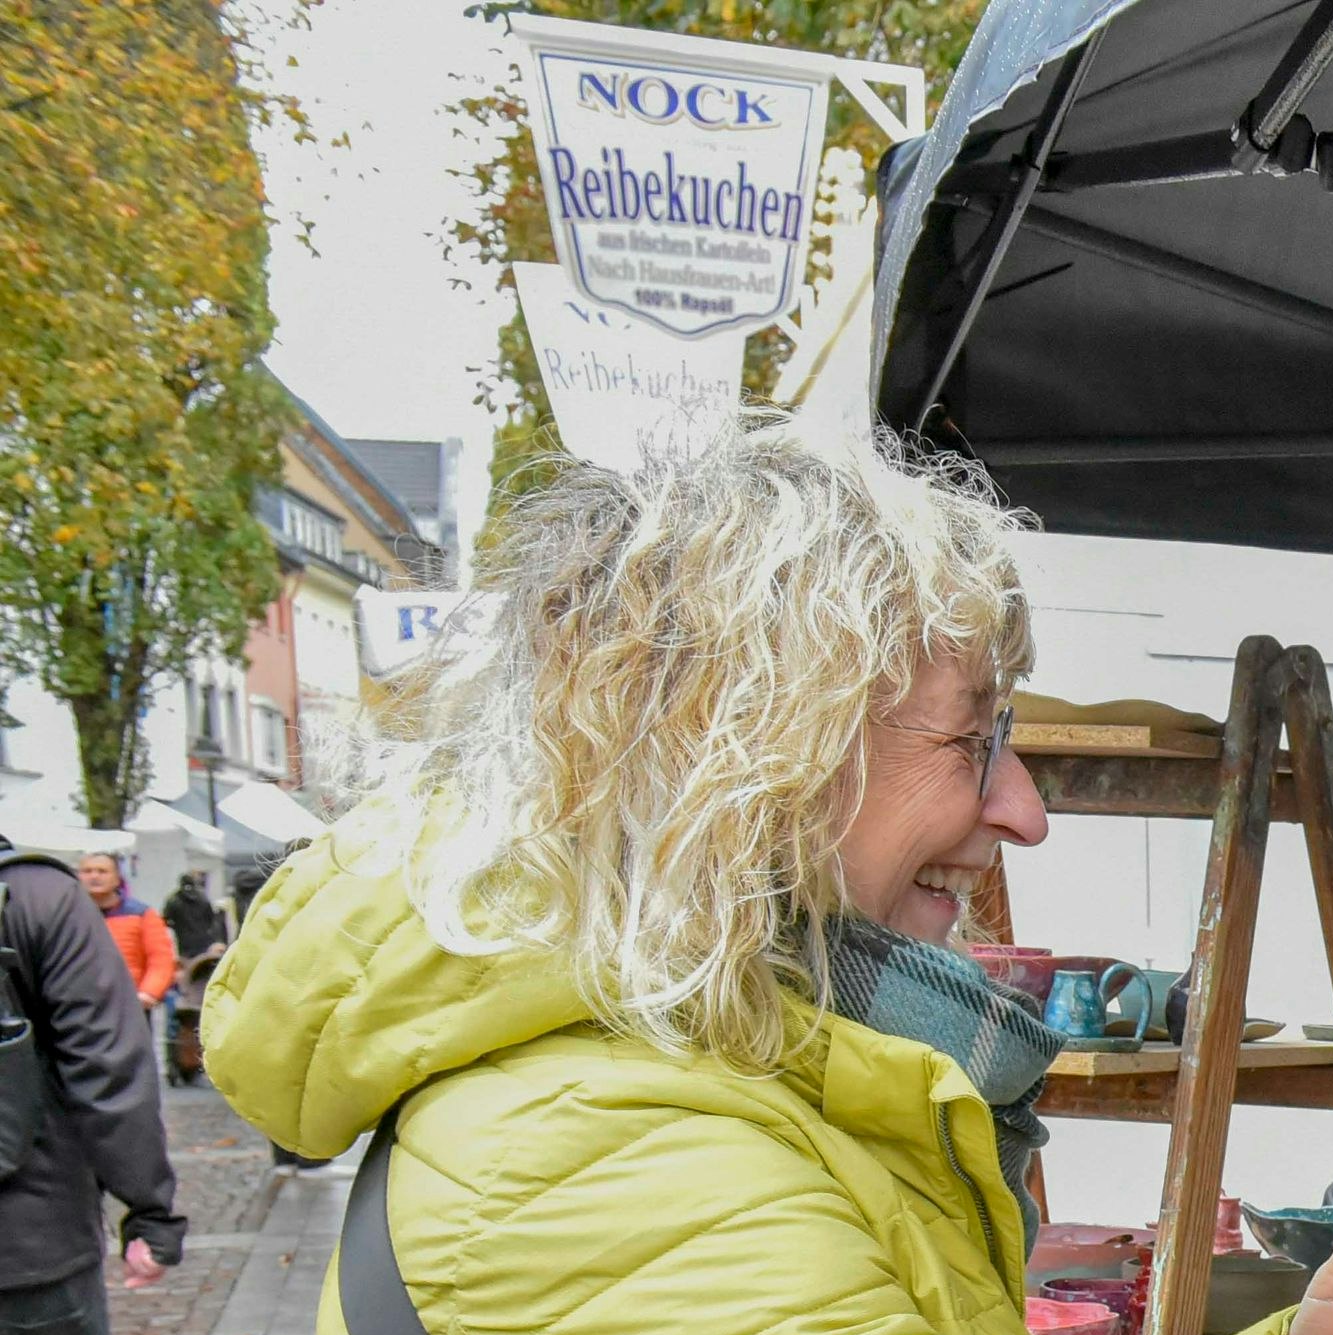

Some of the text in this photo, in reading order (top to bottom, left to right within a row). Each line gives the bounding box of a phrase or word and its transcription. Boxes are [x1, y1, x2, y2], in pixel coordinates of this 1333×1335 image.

[577, 72, 777, 127] NOCK
[548, 147, 804, 241] Reibekuchen
[598, 229, 772, 264] aus frischen Kartoffeln
[587, 254, 636, 281] Nach
[636, 287, 734, 315] 100% Rapsöl
